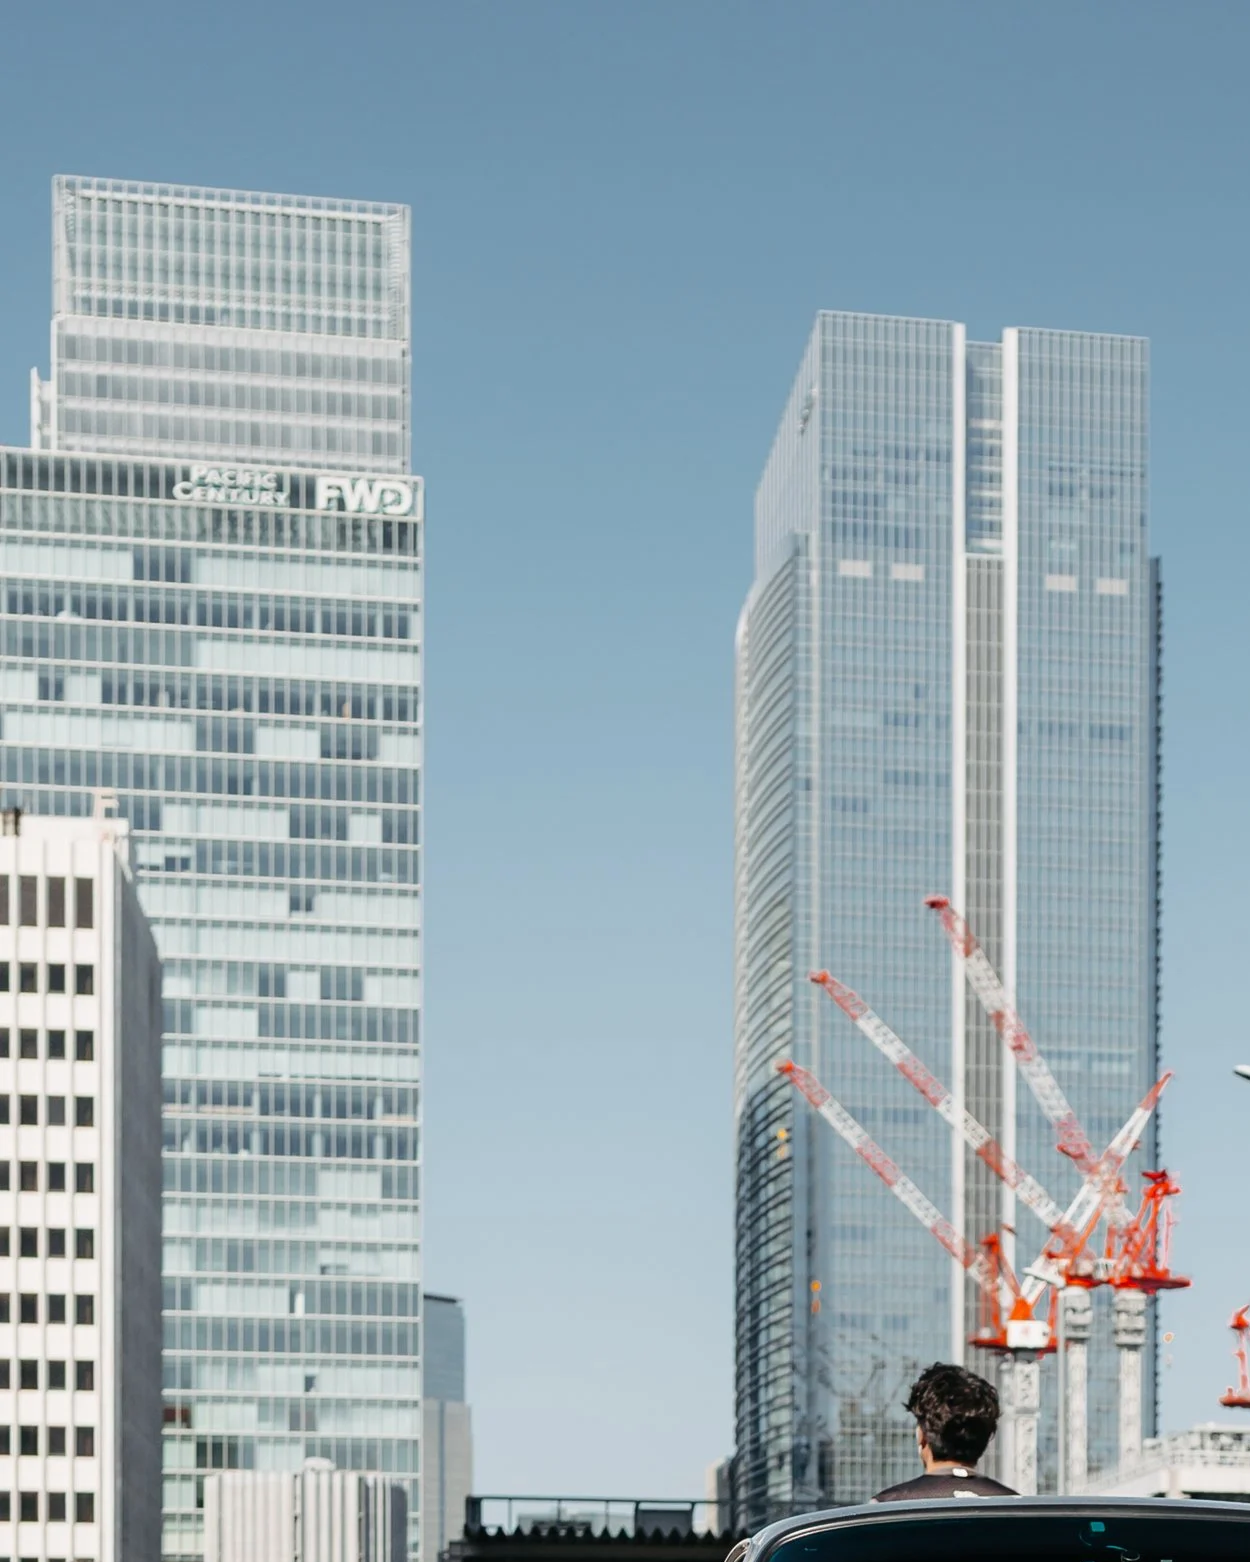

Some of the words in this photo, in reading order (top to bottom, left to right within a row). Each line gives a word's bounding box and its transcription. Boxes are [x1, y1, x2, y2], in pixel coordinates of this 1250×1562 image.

[191, 465, 277, 489] PACIFIC
[172, 481, 290, 507] CENTURY
[315, 476, 413, 515] FWD
